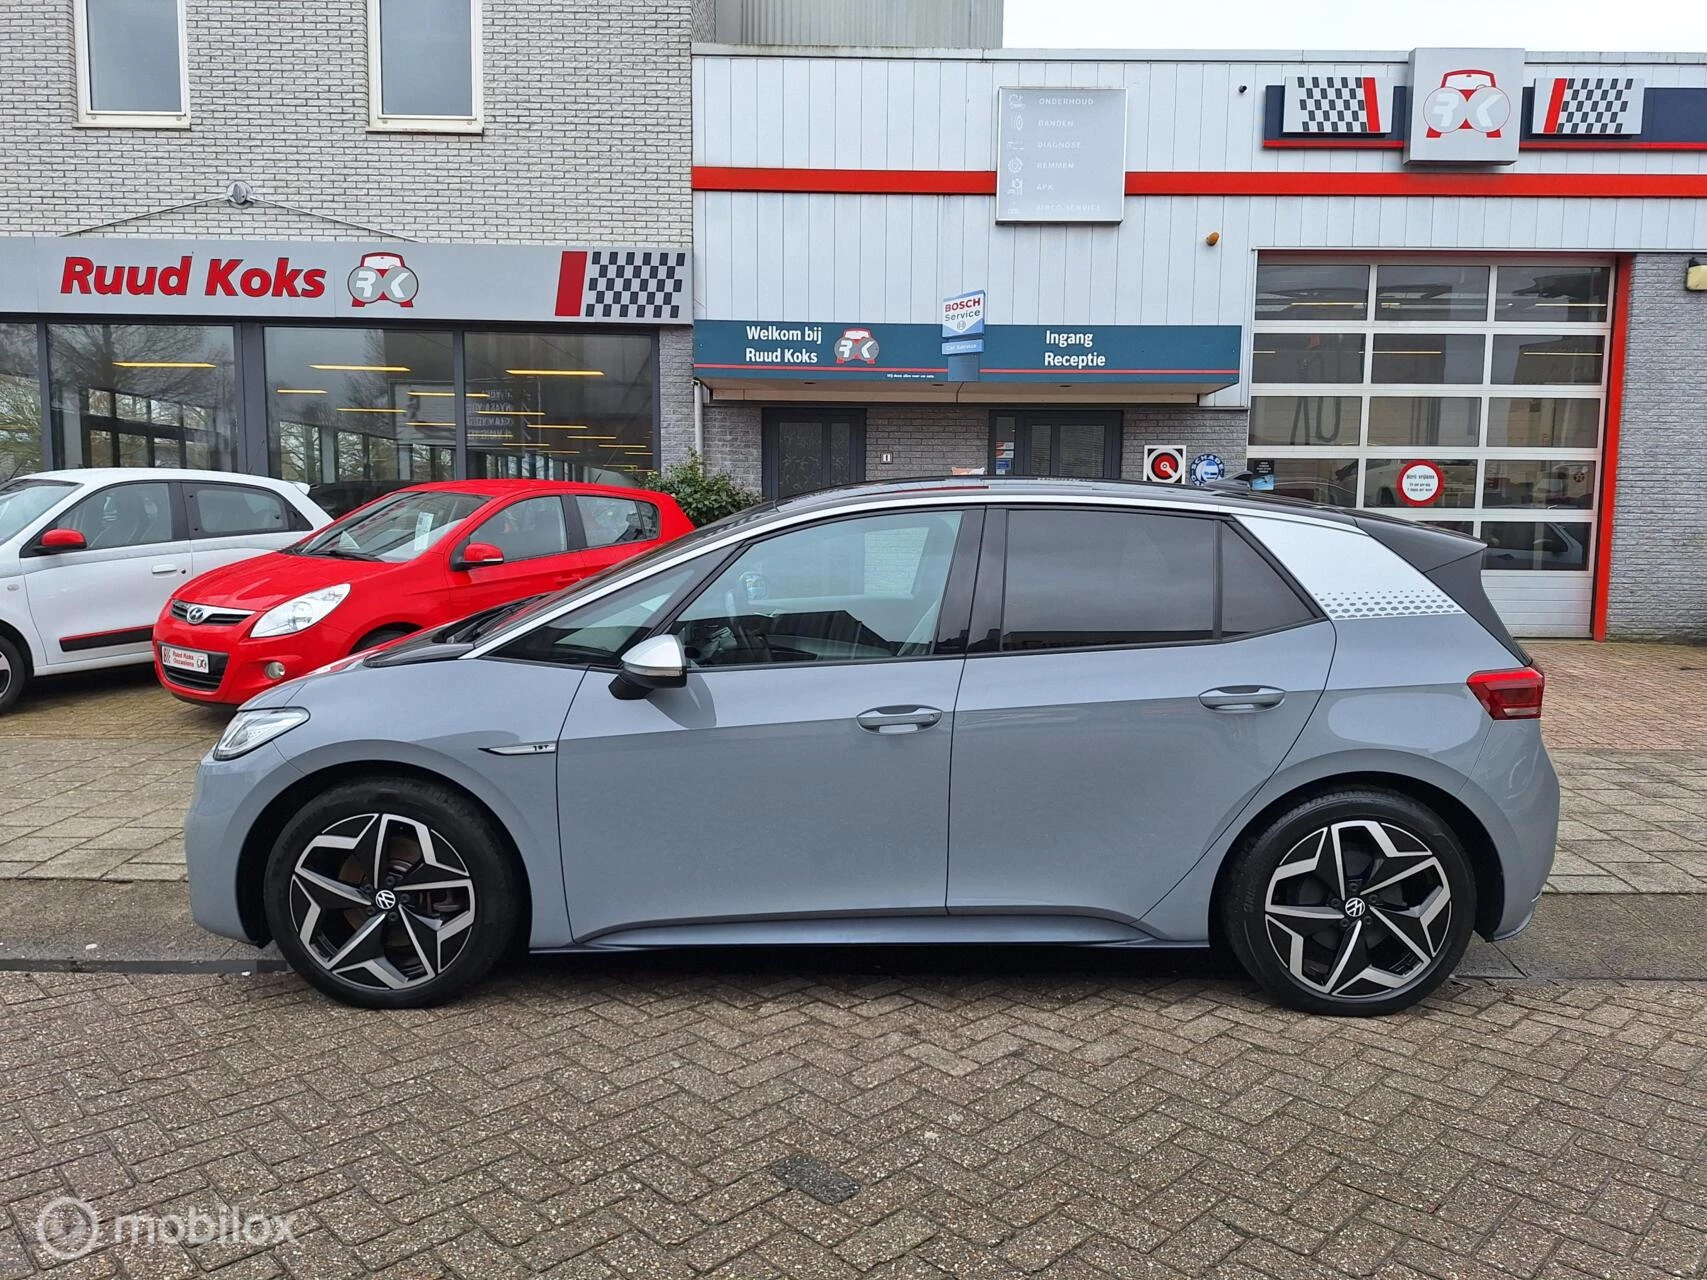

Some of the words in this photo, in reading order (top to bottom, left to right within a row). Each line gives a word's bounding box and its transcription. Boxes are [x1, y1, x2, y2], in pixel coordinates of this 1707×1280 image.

[1038, 97, 1095, 106] ONDERHOUD
[1037, 119, 1074, 127] BANDEN
[1037, 141, 1081, 149] DIAGNOSE
[1036, 162, 1075, 170] REMMEN
[60, 255, 193, 296] Ruud
[204, 257, 327, 298] Koks
[944, 297, 981, 313] BOSCH
[944, 309, 981, 322] Service
[745, 325, 801, 341] Welkom
[804, 326, 822, 345] bij
[1045, 329, 1094, 348] Ingang
[745, 347, 781, 362] Ruud
[784, 348, 818, 363] Koks
[1044, 351, 1106, 370] Receptie
